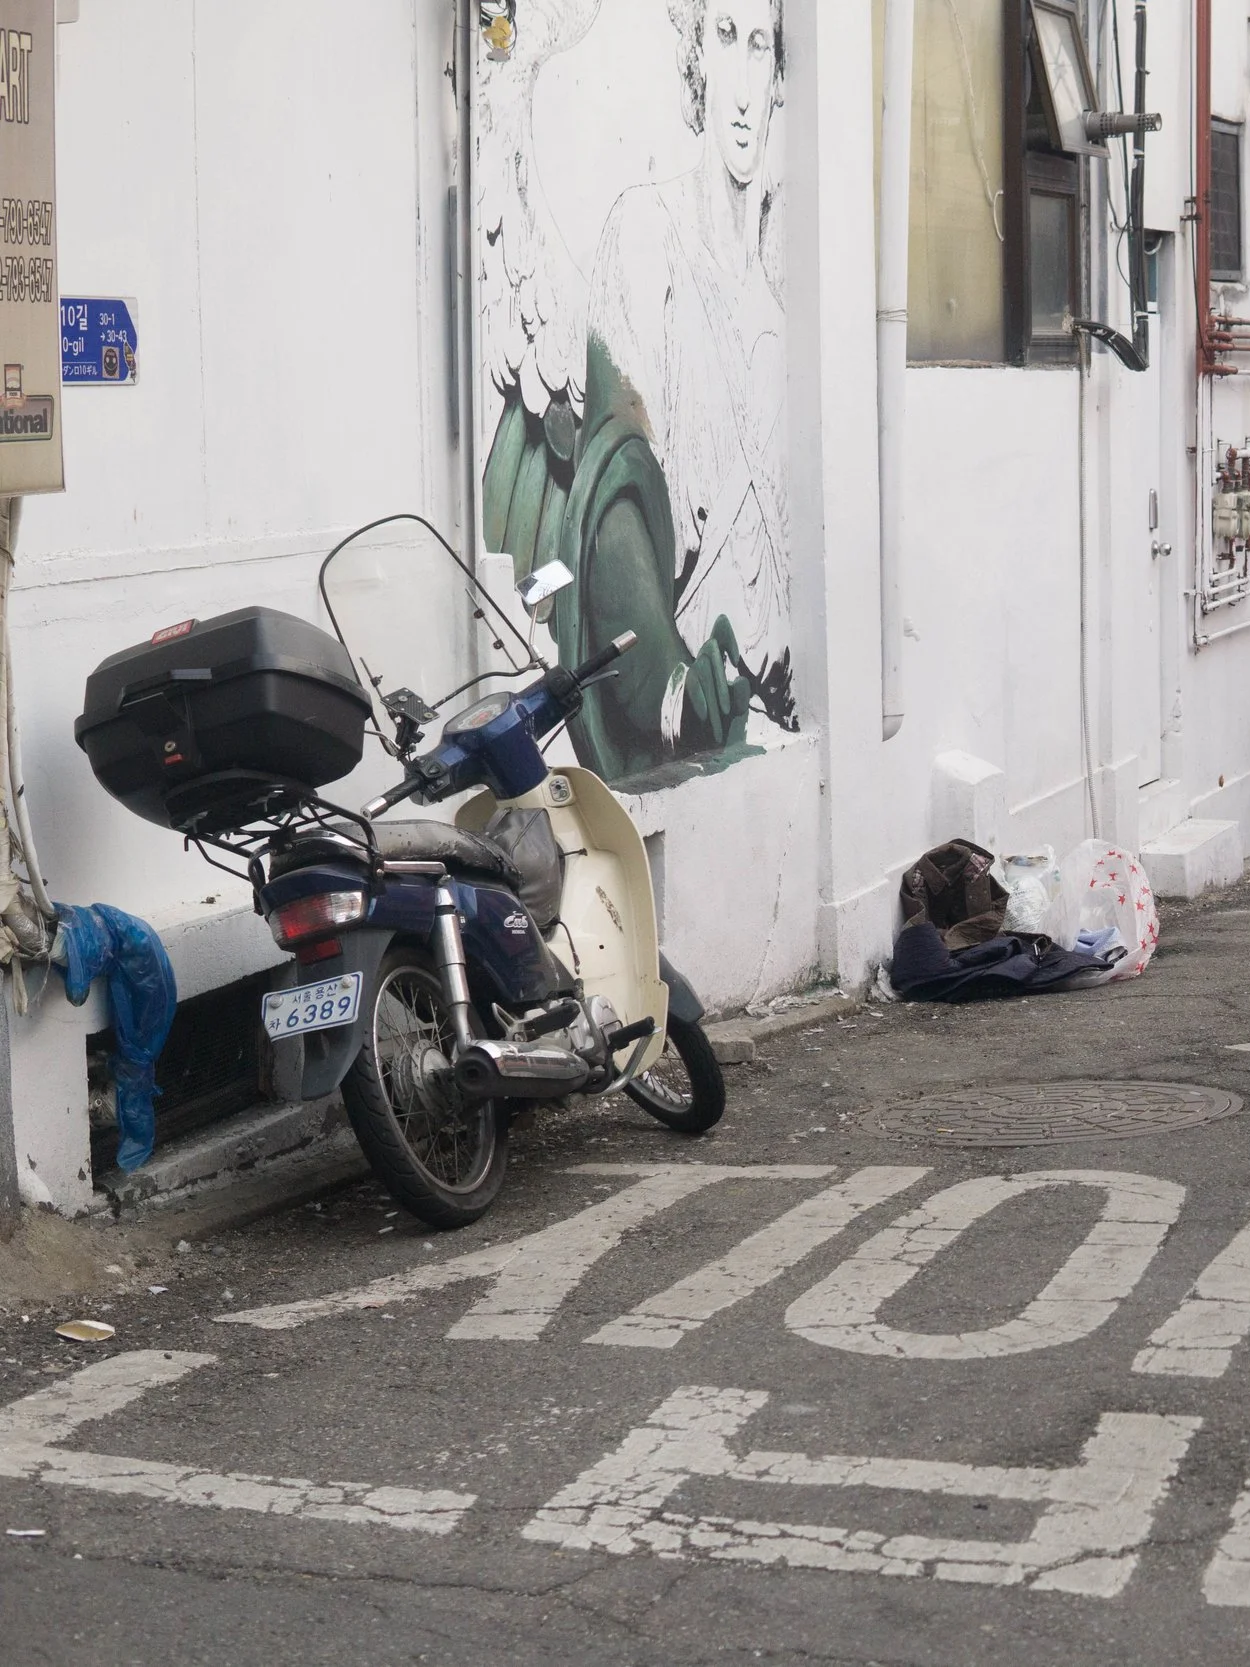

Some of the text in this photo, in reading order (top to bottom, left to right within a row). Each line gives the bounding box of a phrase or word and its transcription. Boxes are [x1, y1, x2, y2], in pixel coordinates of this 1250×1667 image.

[61, 304, 88, 331] 10길
[99, 312, 115, 326] 30-1
[292, 982, 338, 1004] 서울 용산
[286, 996, 351, 1028] 6389
